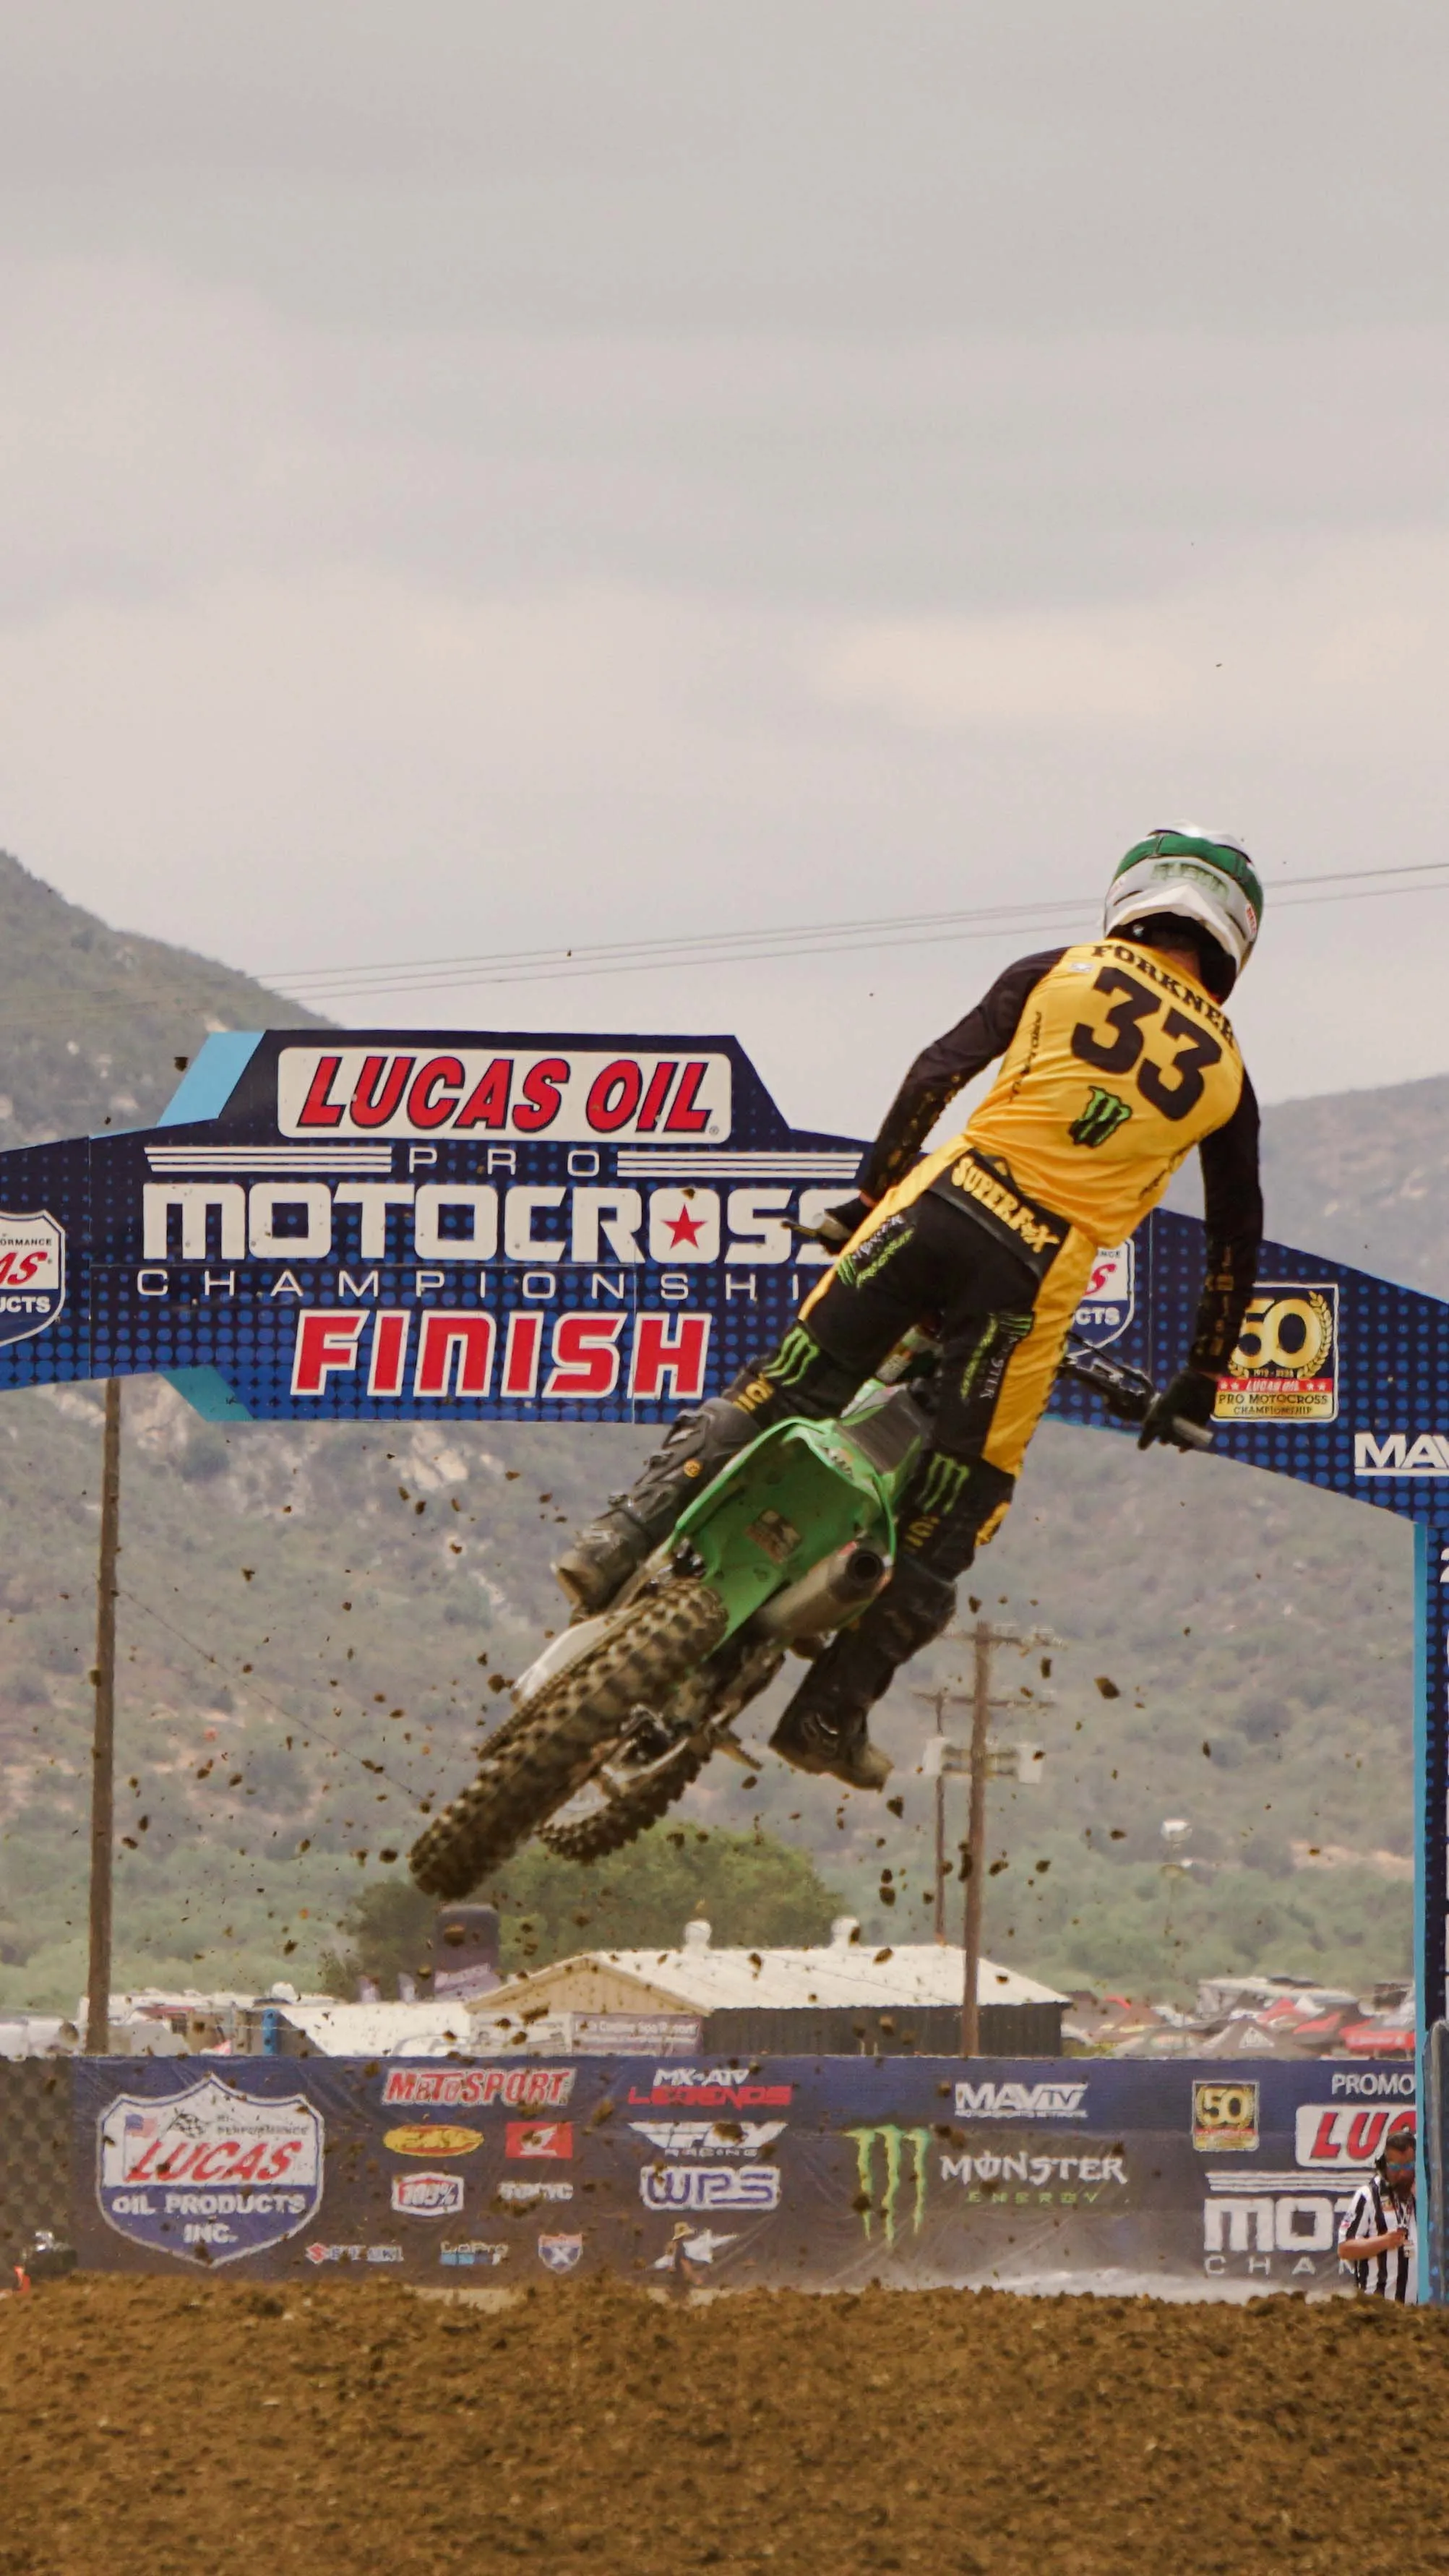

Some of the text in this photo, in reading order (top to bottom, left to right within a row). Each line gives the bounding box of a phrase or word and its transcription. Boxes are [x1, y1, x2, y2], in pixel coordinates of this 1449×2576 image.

[1091, 945, 1234, 1049] FORKNER
[1070, 965, 1223, 1122] 33
[296, 1055, 713, 1133] LUCAS OIL
[409, 1148, 599, 1176] PRO
[137, 1268, 799, 1300] CHAMPIONSHI
[1231, 1297, 1322, 1368] 50
[290, 1309, 713, 1399] FINISH
[1218, 1394, 1328, 1405] PRO MOTOCROSS
[1203, 2088, 1250, 2126] 50
[124, 2140, 304, 2183] LUCAS
[940, 2150, 1128, 2185] MONSTER
[112, 2193, 306, 2215] OIL PRODUCTS
[643, 2168, 778, 2207] WPS
